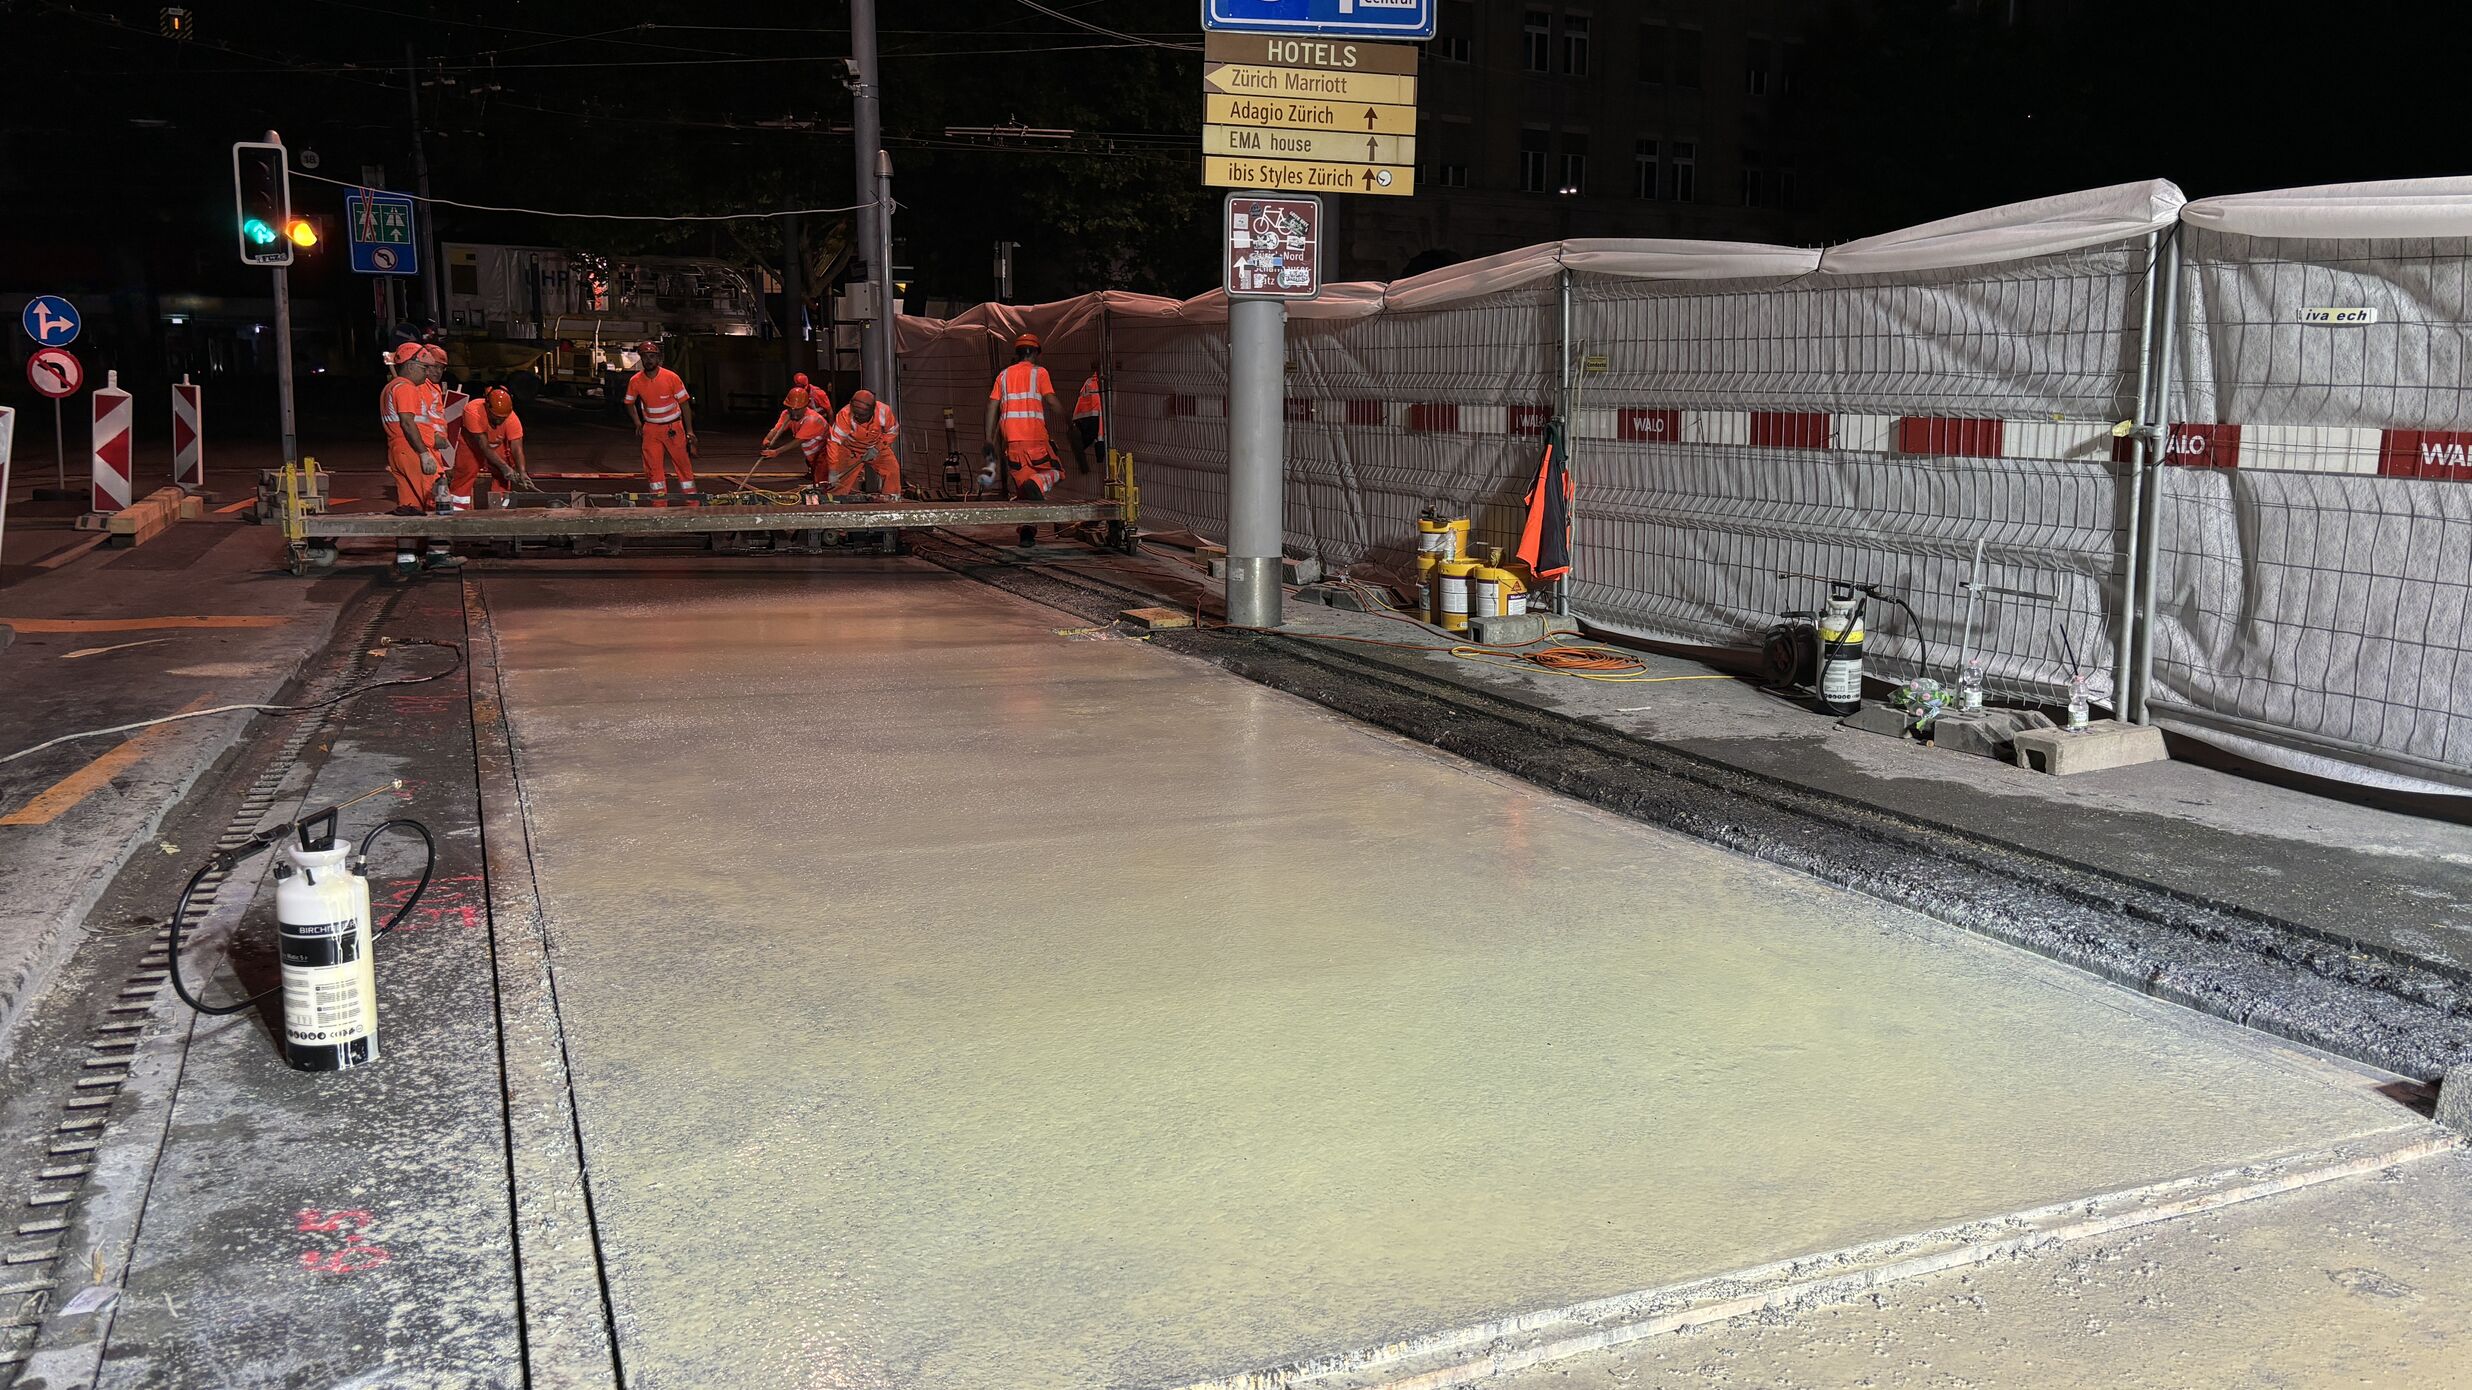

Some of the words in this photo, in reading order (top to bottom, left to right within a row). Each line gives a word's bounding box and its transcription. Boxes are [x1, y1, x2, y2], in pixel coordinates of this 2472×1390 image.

[1267, 40, 1357, 67] HOTELS
[1231, 69, 1277, 89] Zürich
[1285, 72, 1348, 94] Marriott
[1230, 101, 1283, 124] Adagio
[1288, 104, 1334, 125] Zürich
[1229, 131, 1261, 150] EMA
[1270, 133, 1312, 152] house
[1228, 162, 1255, 182] ibis
[1259, 165, 1303, 188] Styles
[1308, 168, 1353, 187] Zürich
[2305, 309, 2329, 321] iva
[2336, 310, 2367, 321] ech
[1633, 417, 1664, 433] WALO
